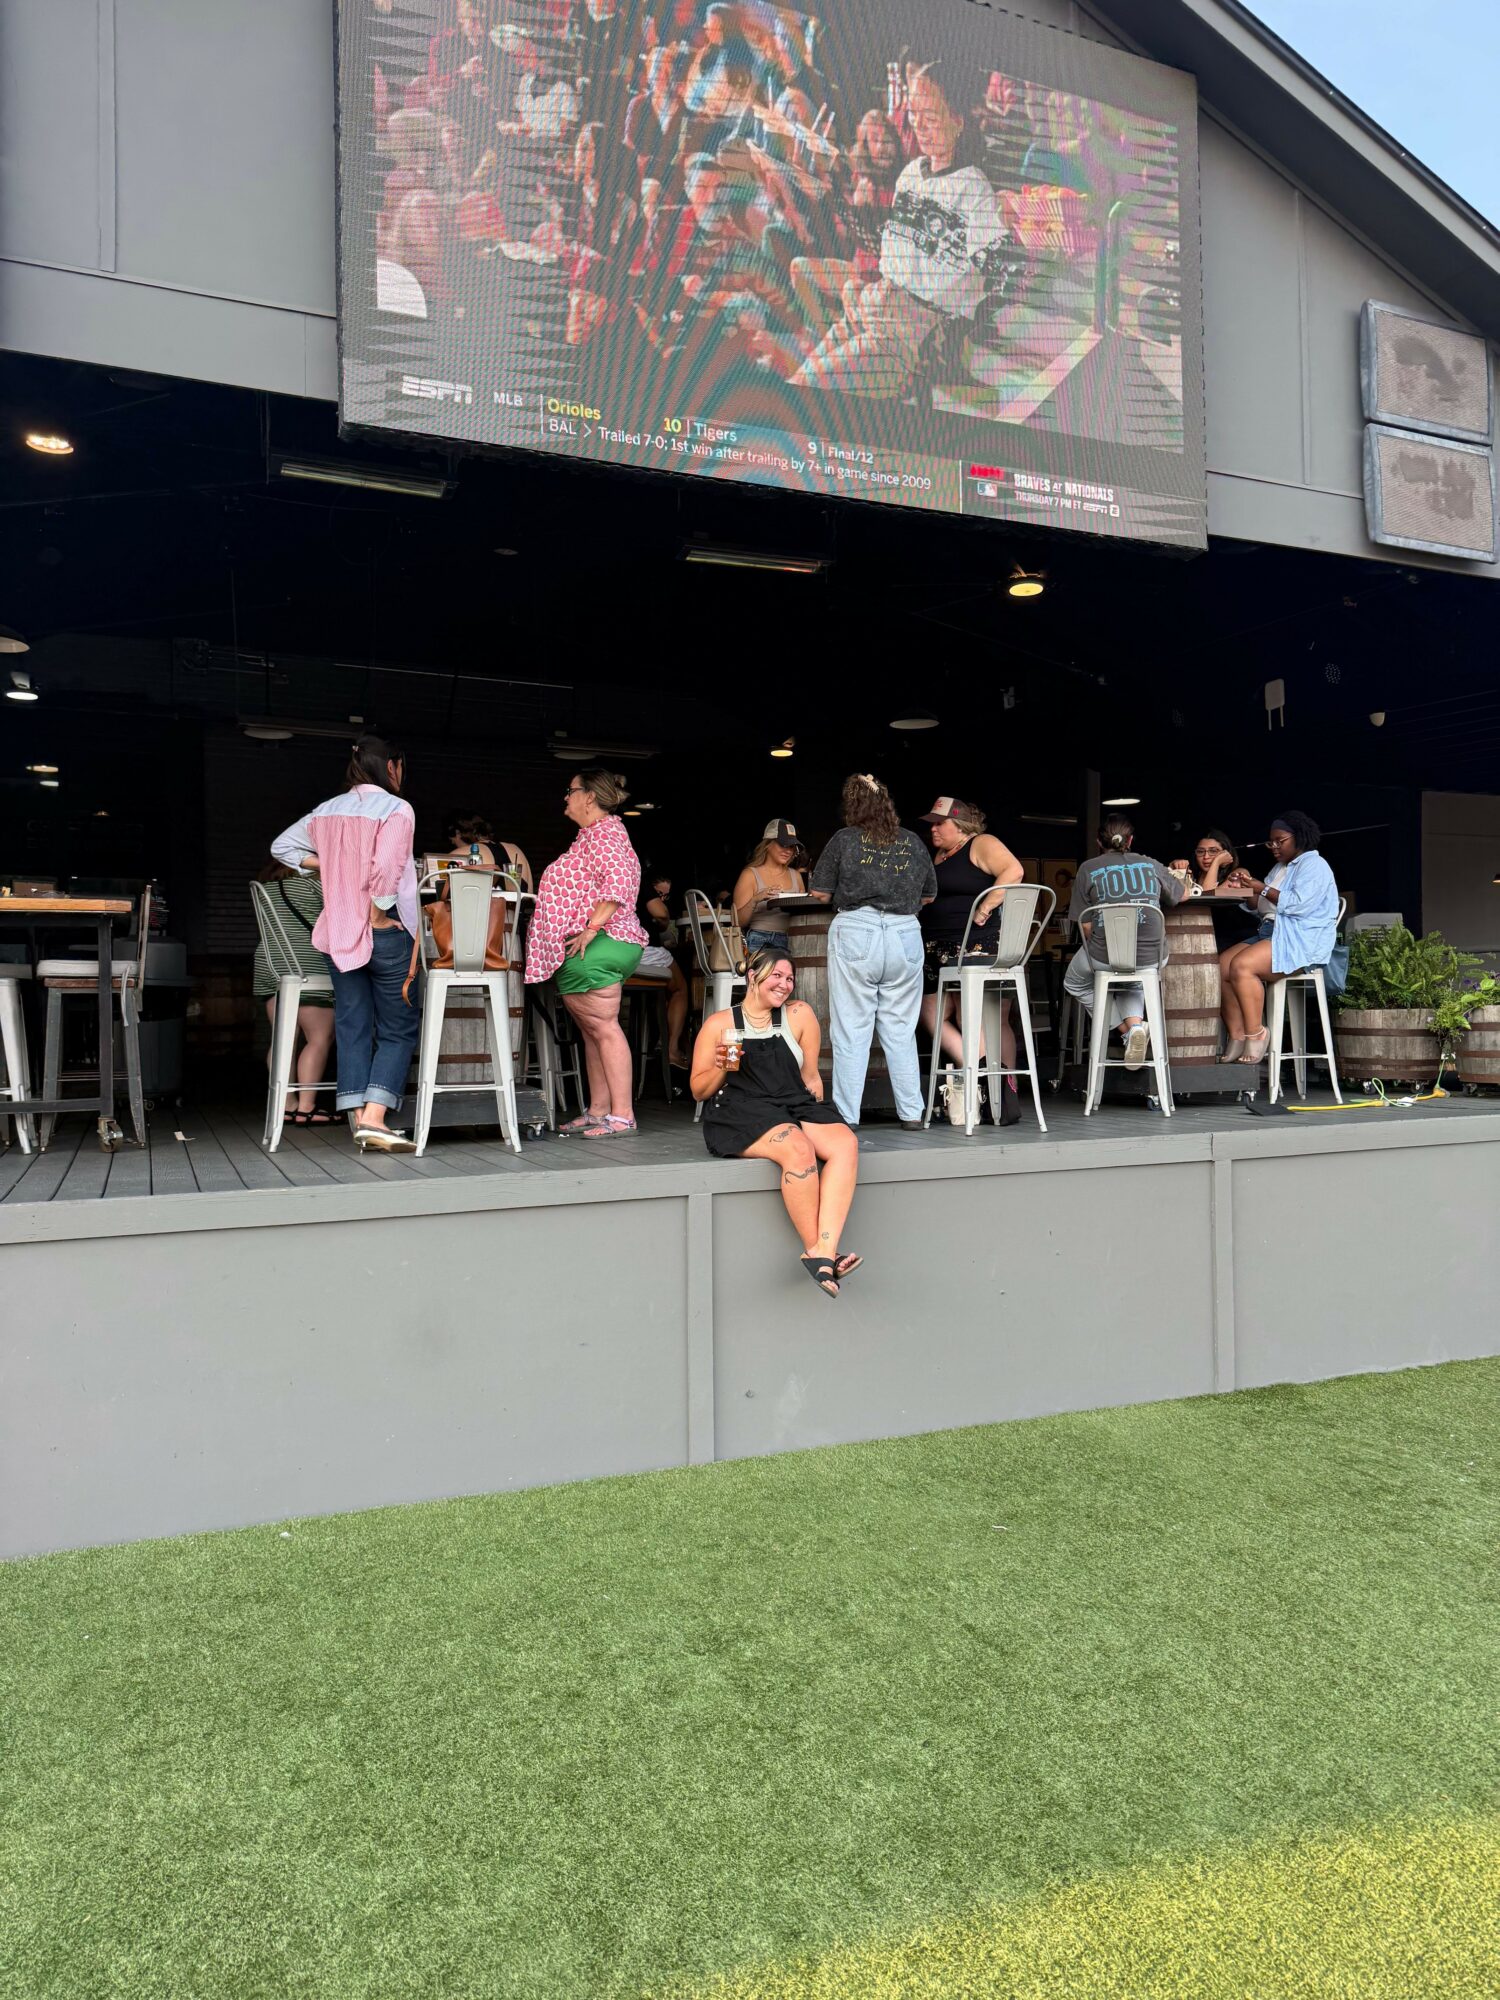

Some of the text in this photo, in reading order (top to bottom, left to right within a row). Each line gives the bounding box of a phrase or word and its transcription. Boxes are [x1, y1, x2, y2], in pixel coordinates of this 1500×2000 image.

[402, 375, 473, 404] ESPN
[492, 392, 523, 406] MLB
[547, 398, 682, 433] Orioles 10
[693, 422, 818, 455] Tigers 9
[549, 418, 931, 490] BAL Trailed 7-0; 1st win after trailing by 7+ in game since 2009
[828, 446, 874, 465] Final/12
[1013, 473, 1114, 502] BRAVES AT NATIONALS
[1014, 491, 1053, 506] THURSDAY
[1054, 497, 1059, 507] 7
[1060, 498, 1072, 509] PM
[1073, 500, 1081, 510] ET
[1083, 502, 1108, 514] ESPN
[1091, 867, 1158, 900] TOUR
